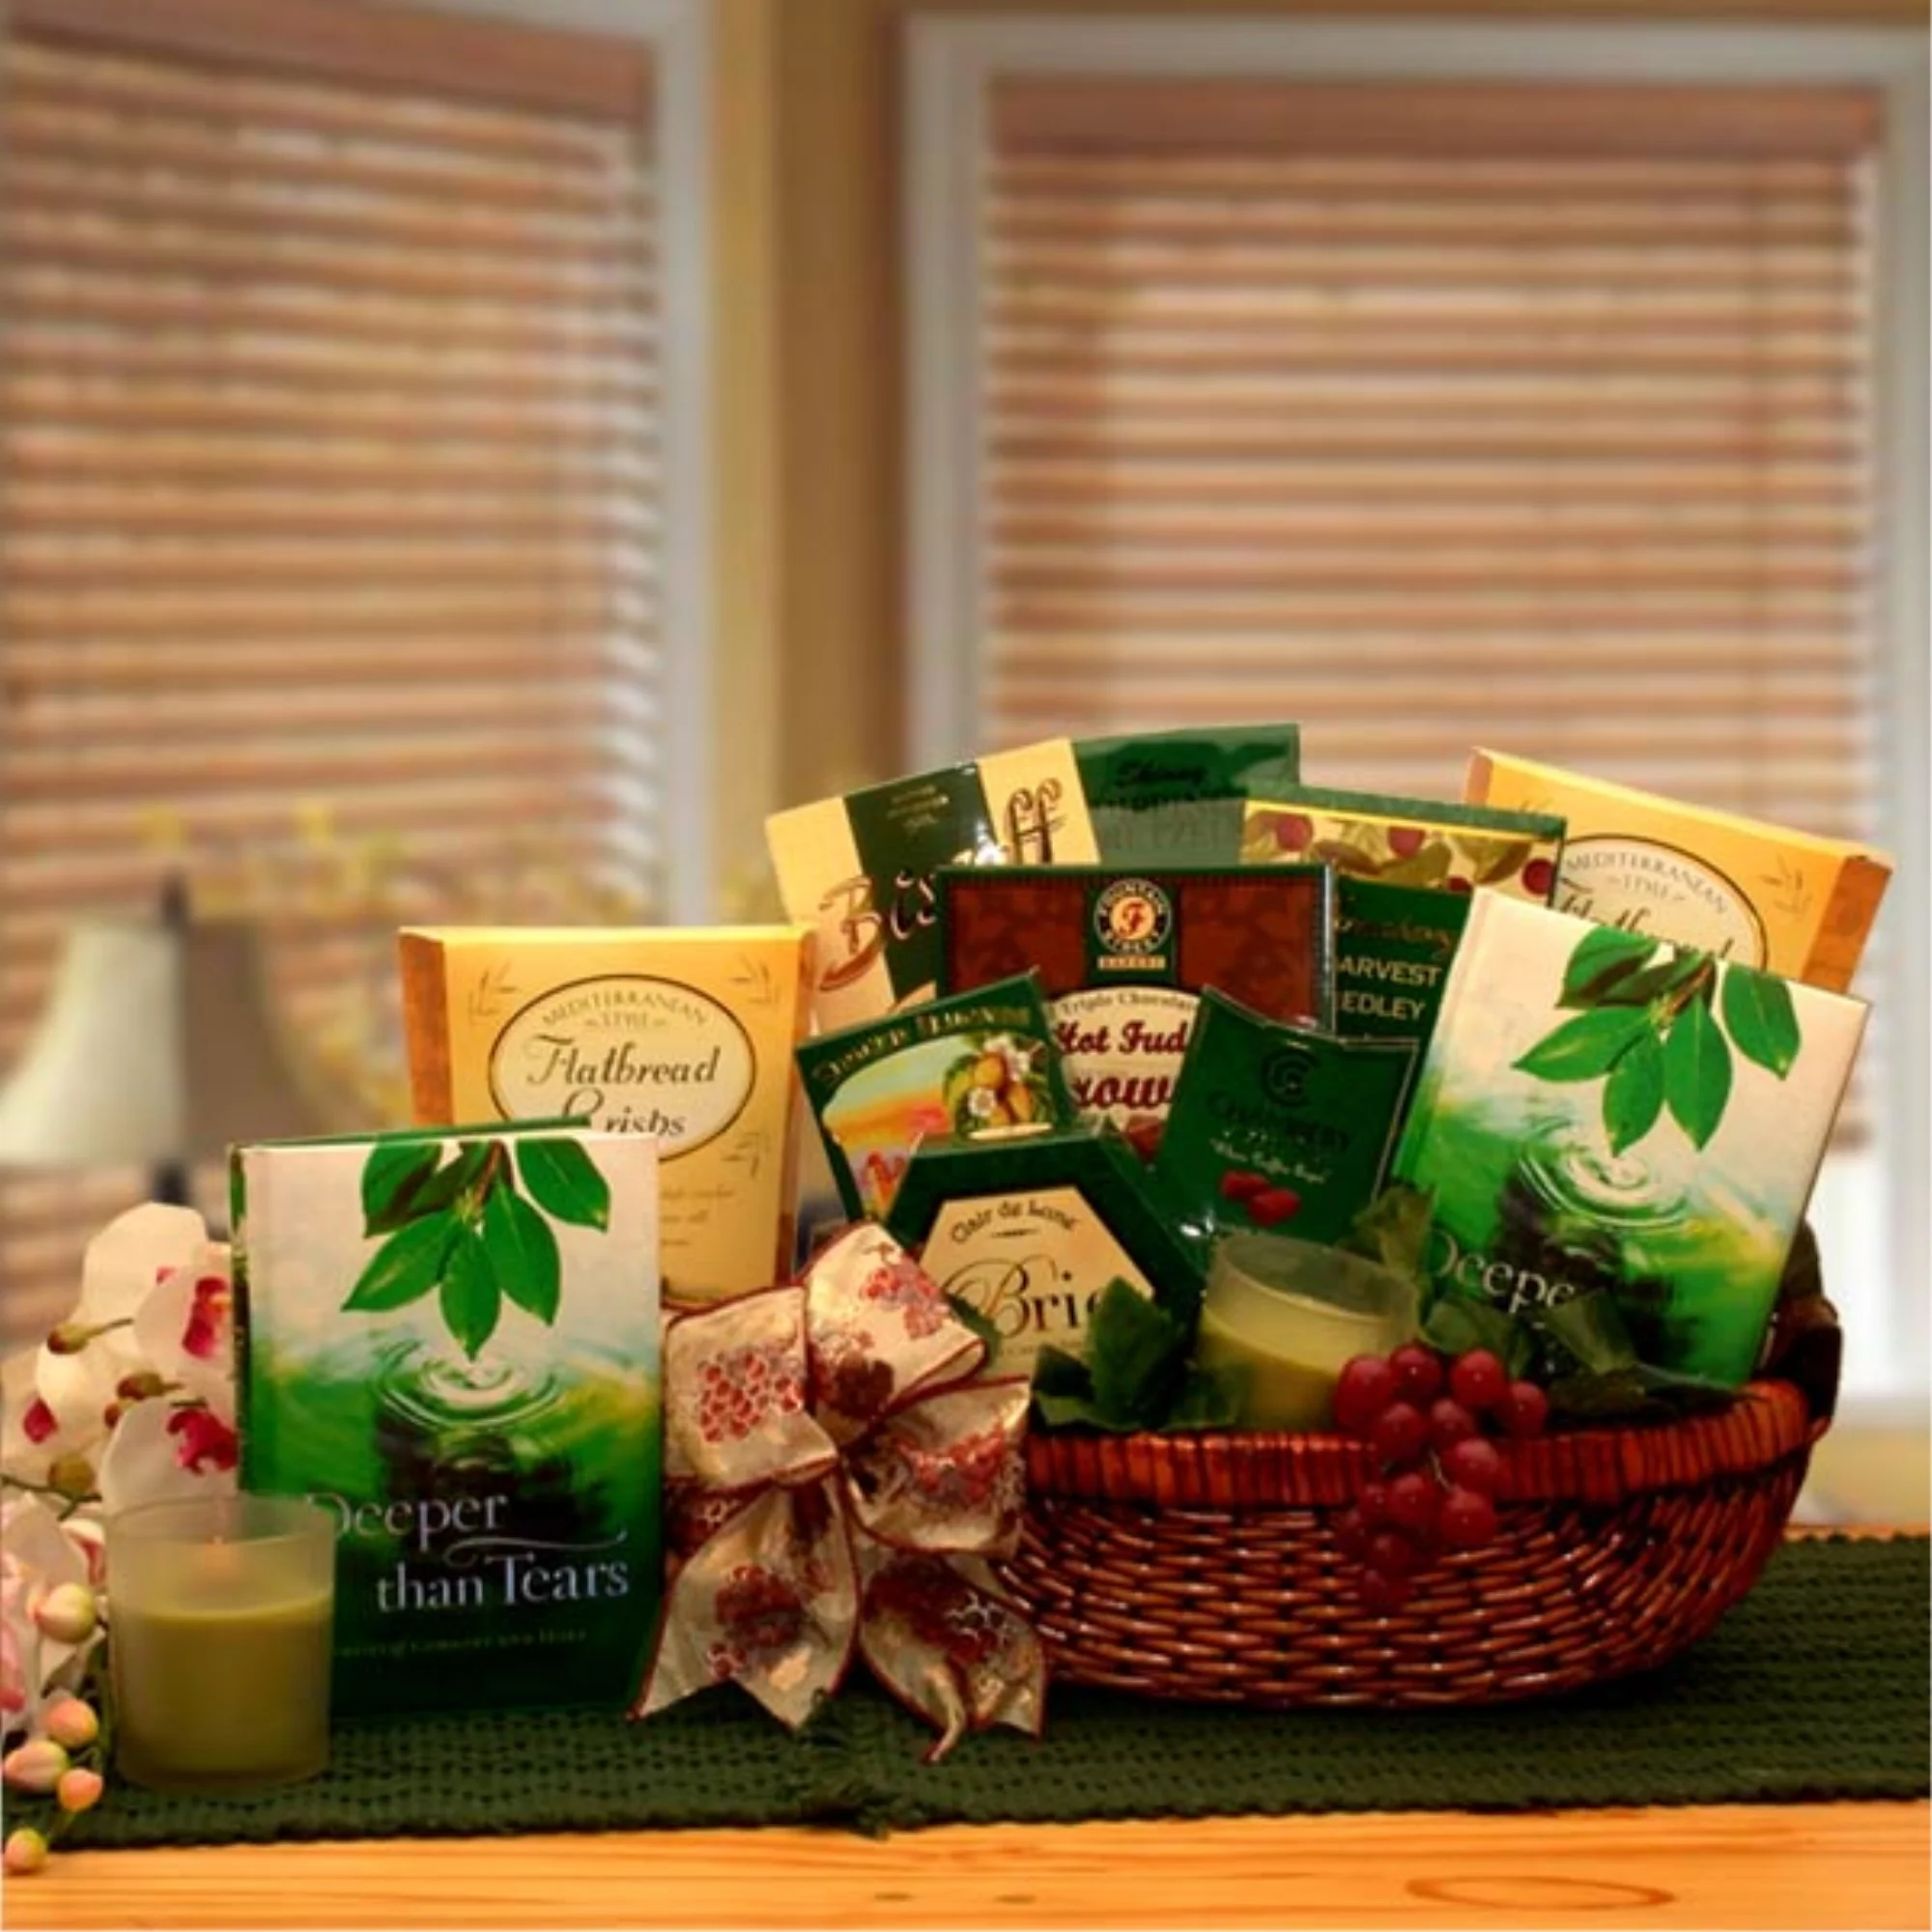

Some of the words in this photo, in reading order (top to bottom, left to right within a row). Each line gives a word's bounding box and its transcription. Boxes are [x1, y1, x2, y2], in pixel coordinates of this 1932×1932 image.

[1338, 952, 1442, 987] ARVEST
[1340, 988, 1427, 1020] EDLEY
[1119, 1019, 1189, 1055] Fud
[526, 1034, 722, 1086] Flatbread
[998, 1200, 1021, 1218] de
[377, 1560, 483, 1614] than
[485, 1550, 630, 1605] Tears
